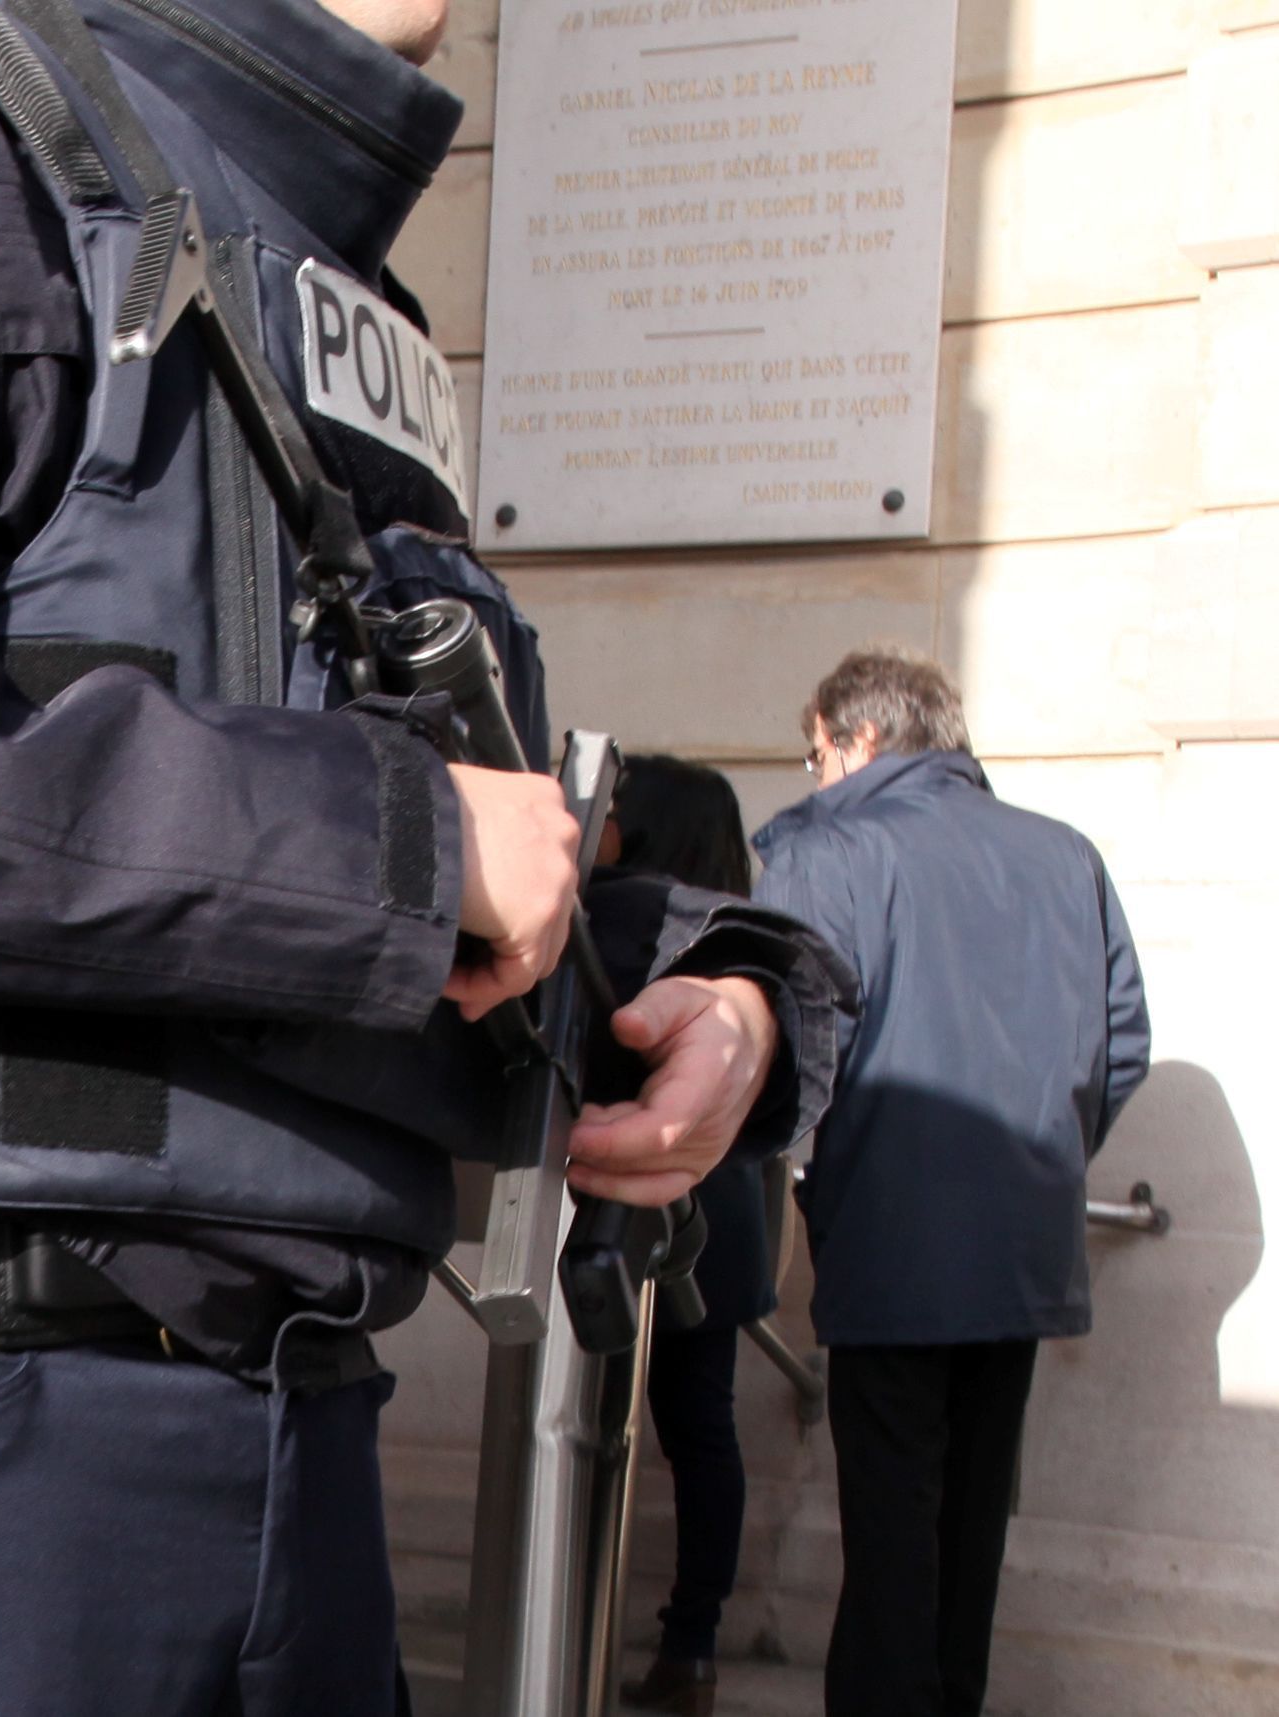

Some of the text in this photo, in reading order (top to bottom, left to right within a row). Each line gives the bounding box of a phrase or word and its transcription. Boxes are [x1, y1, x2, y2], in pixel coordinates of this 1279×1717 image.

[733, 74, 761, 97] DE
[767, 70, 795, 95] LA
[739, 118, 762, 138] DU
[798, 154, 819, 174] DE
[855, 189, 905, 210] PARIS
[627, 249, 656, 268] LES
[762, 239, 785, 259] DE
[662, 286, 683, 306] LE
[715, 282, 761, 303] JUIN
[762, 359, 794, 384] QUI
[721, 404, 745, 423] LA
[810, 399, 831, 418] ET
